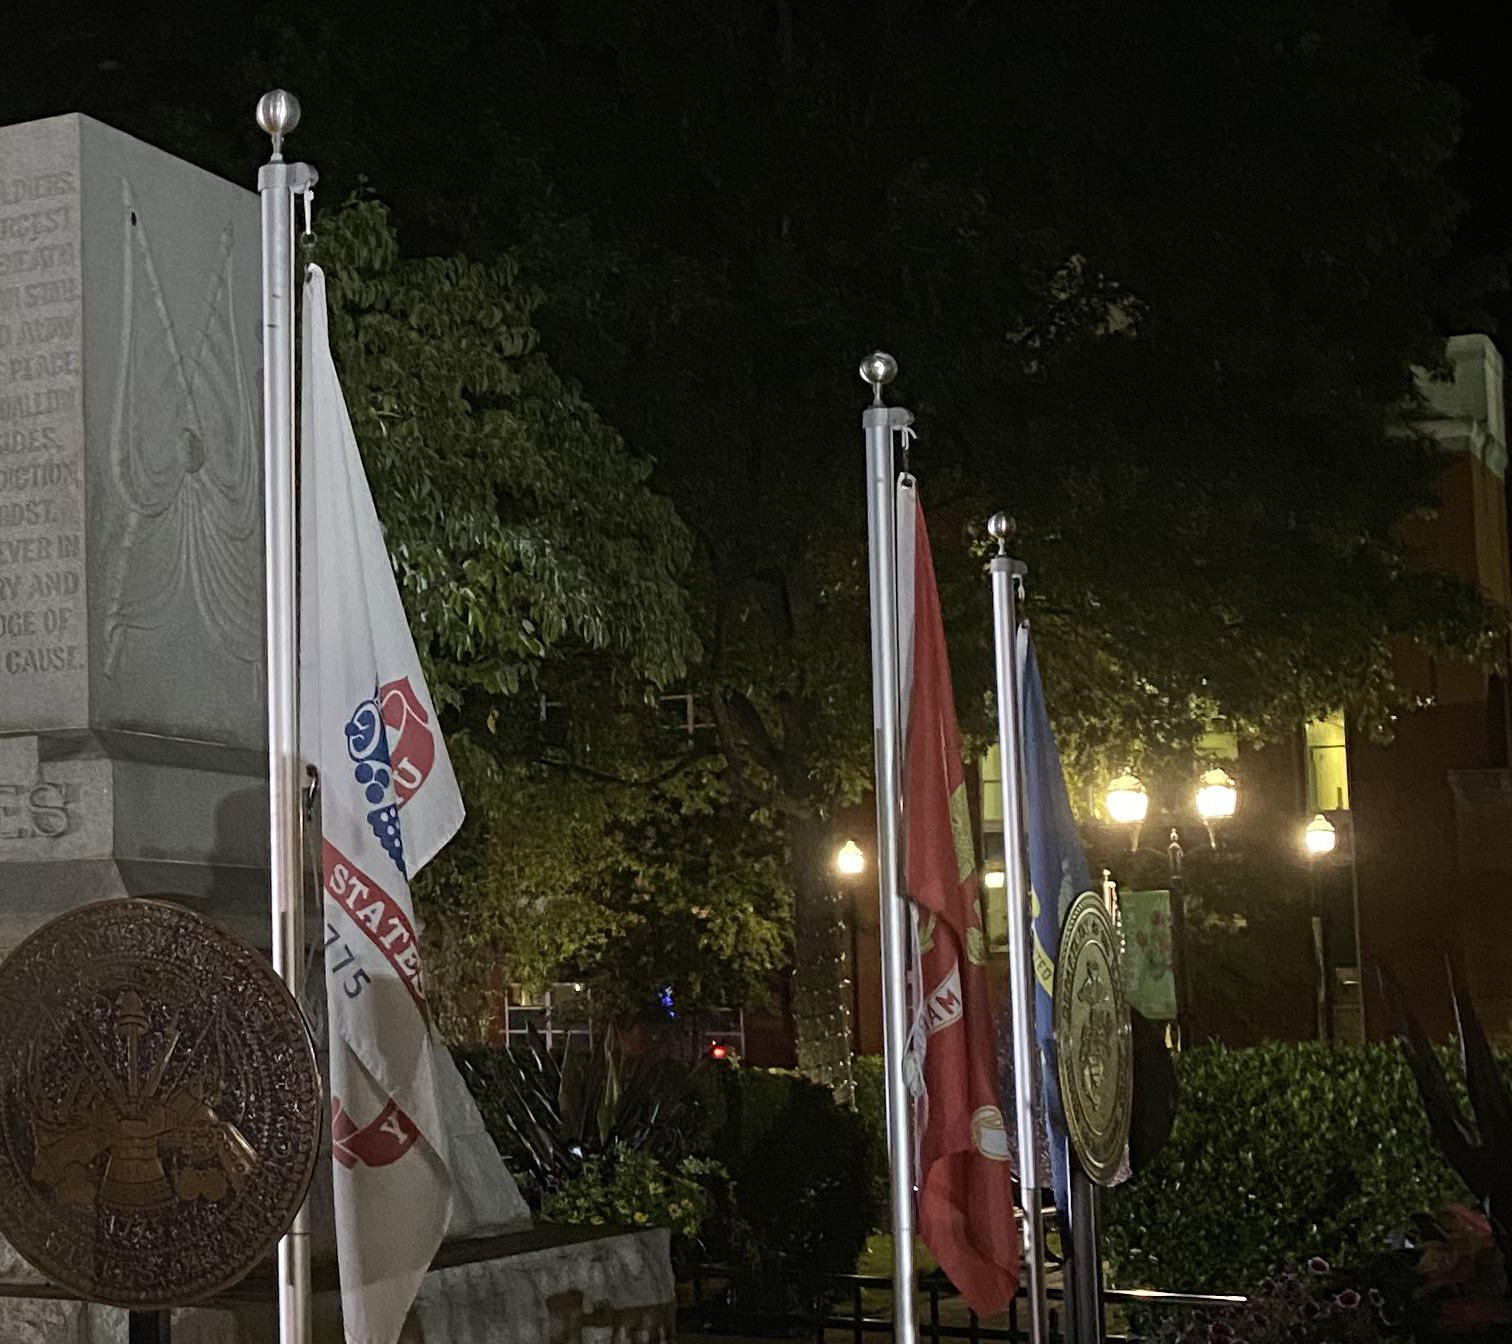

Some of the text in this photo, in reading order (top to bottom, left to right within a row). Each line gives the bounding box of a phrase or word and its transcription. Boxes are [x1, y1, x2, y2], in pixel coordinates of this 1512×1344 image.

[16, 313, 77, 346] AWAY
[57, 533, 80, 560] IN
[27, 570, 80, 601] AND
[43, 607, 73, 637] OF
